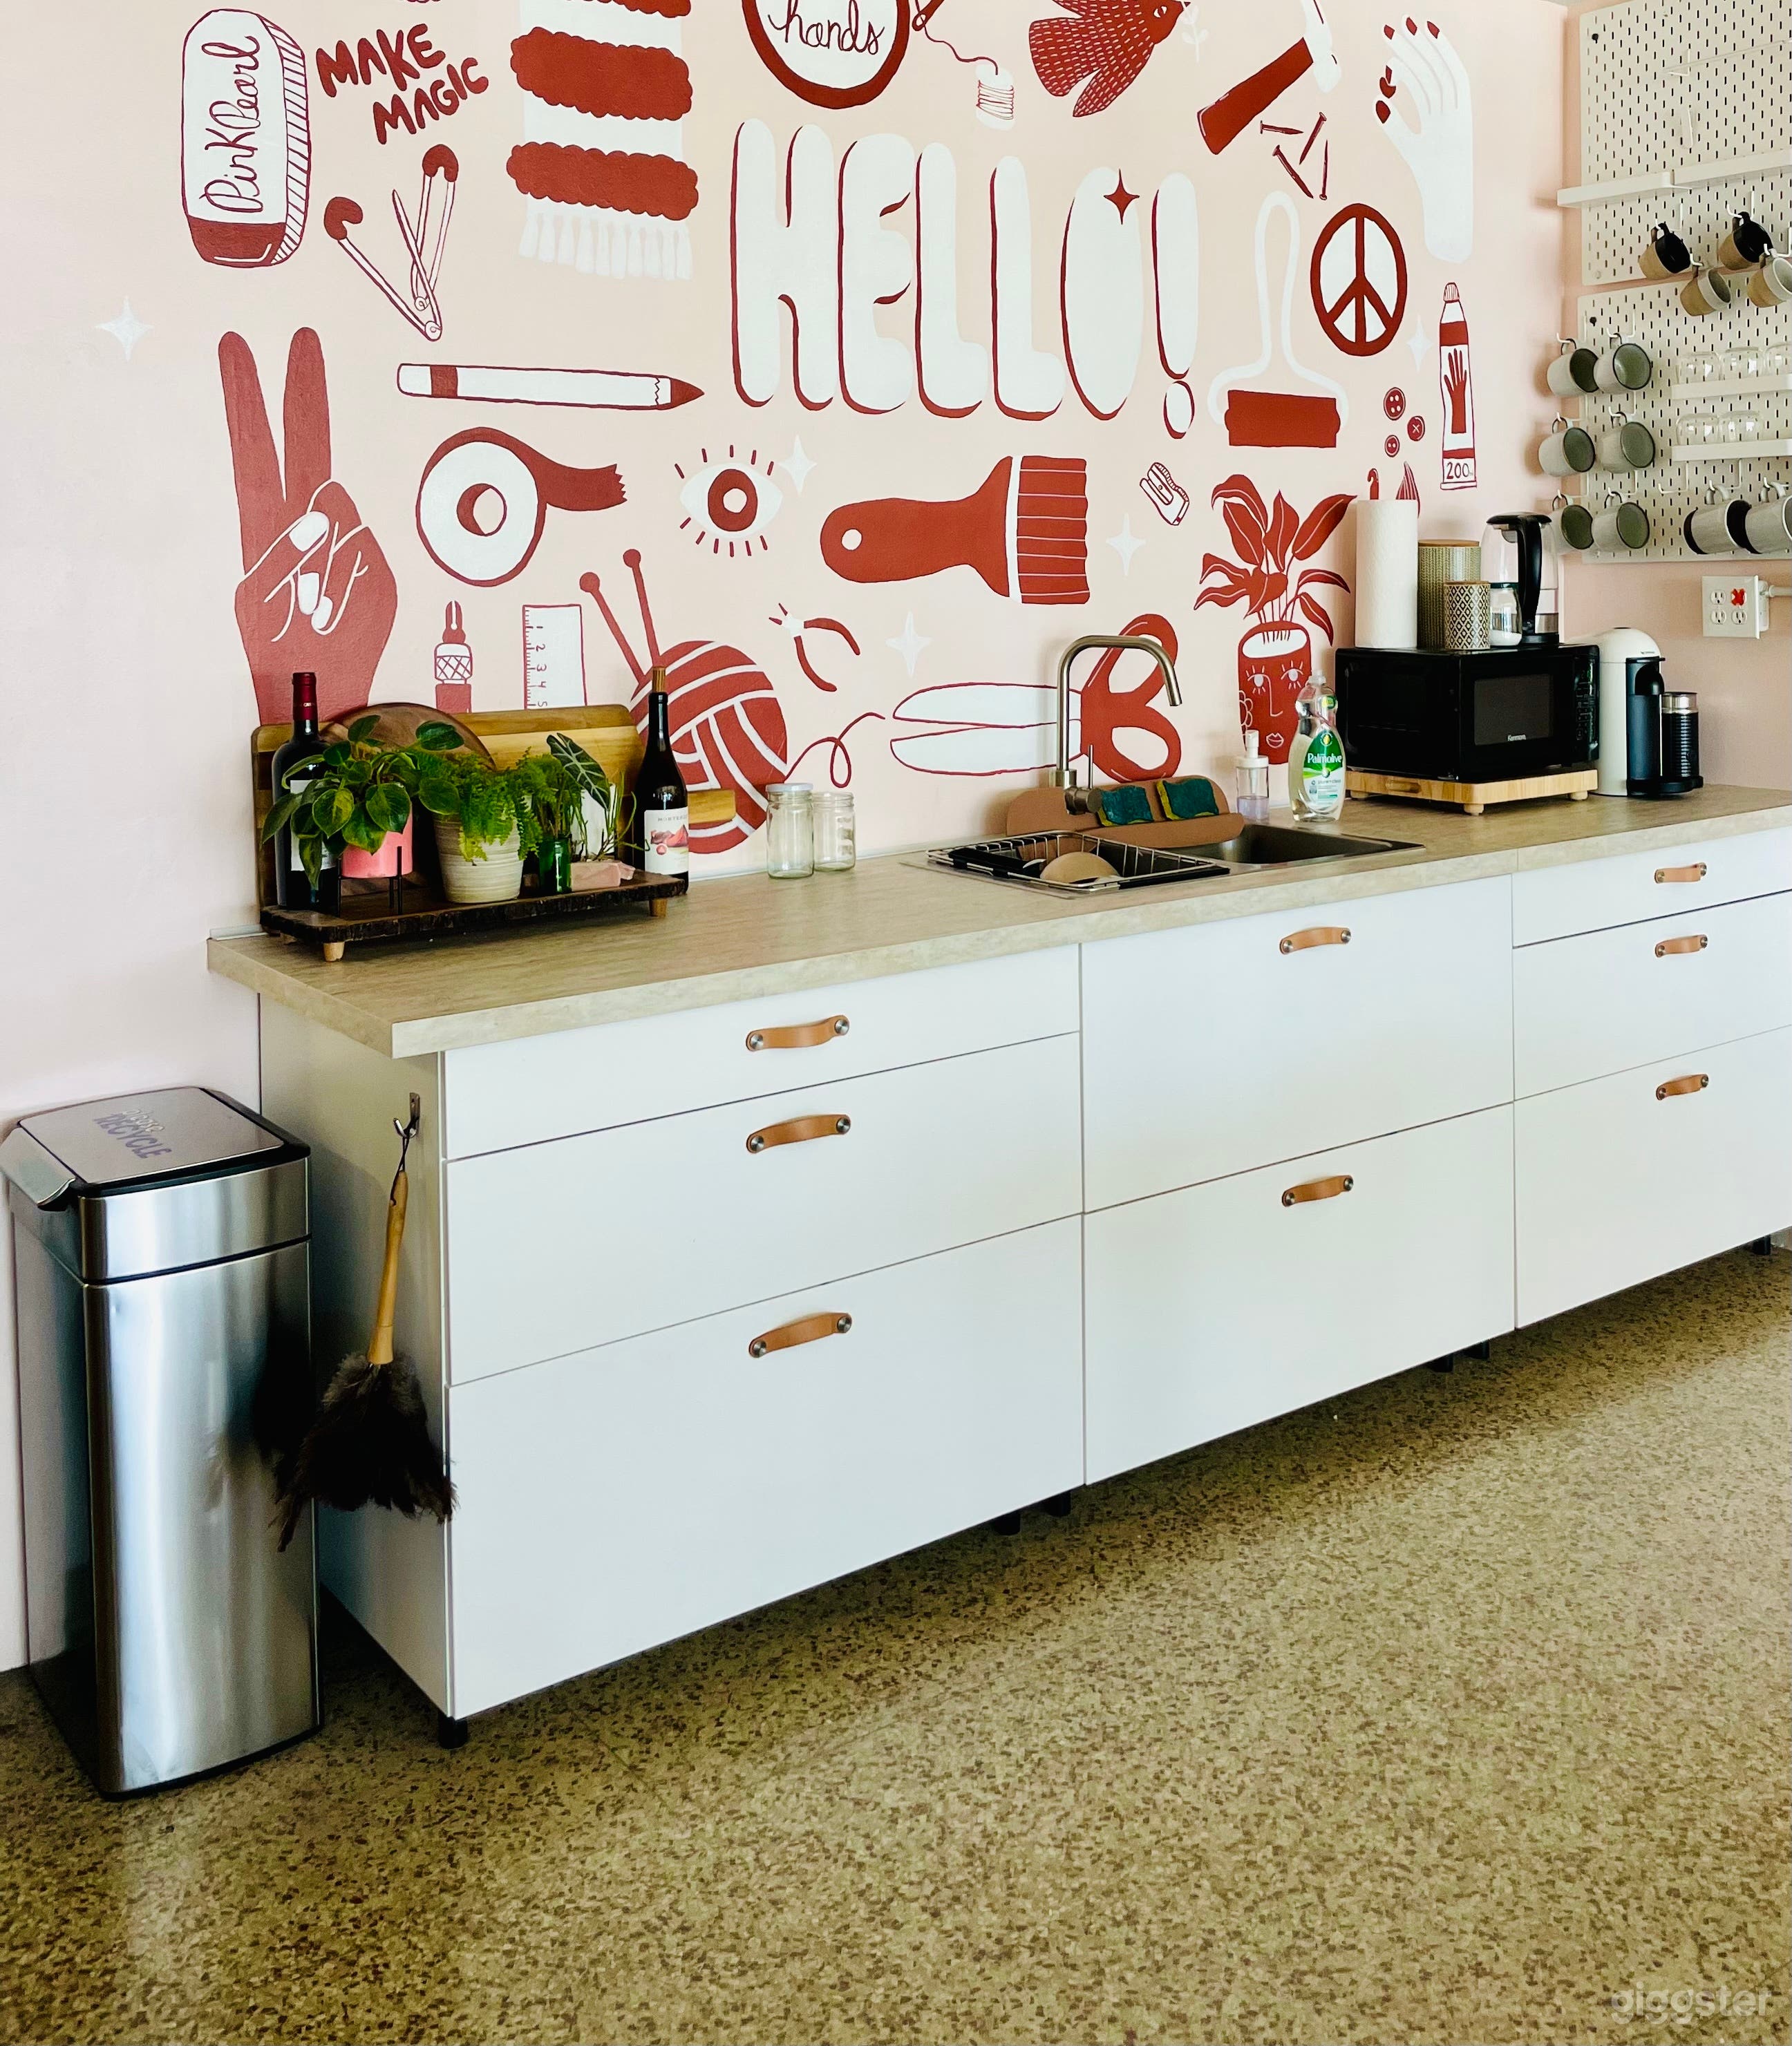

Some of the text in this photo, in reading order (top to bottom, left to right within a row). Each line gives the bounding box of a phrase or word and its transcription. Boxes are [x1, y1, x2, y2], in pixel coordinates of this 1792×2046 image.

[768, 0, 885, 55] hands
[200, 35, 261, 130] Pearl
[315, 23, 446, 98] MAKE
[372, 57, 489, 145] MAGIC
[730, 117, 1199, 439] HELLO!
[536, 643, 546, 652] 2
[536, 663, 547, 672] 3
[537, 681, 547, 689] 4
[1307, 752, 1342, 764] Palmolive
[93, 1112, 172, 1159] RECYCLE
